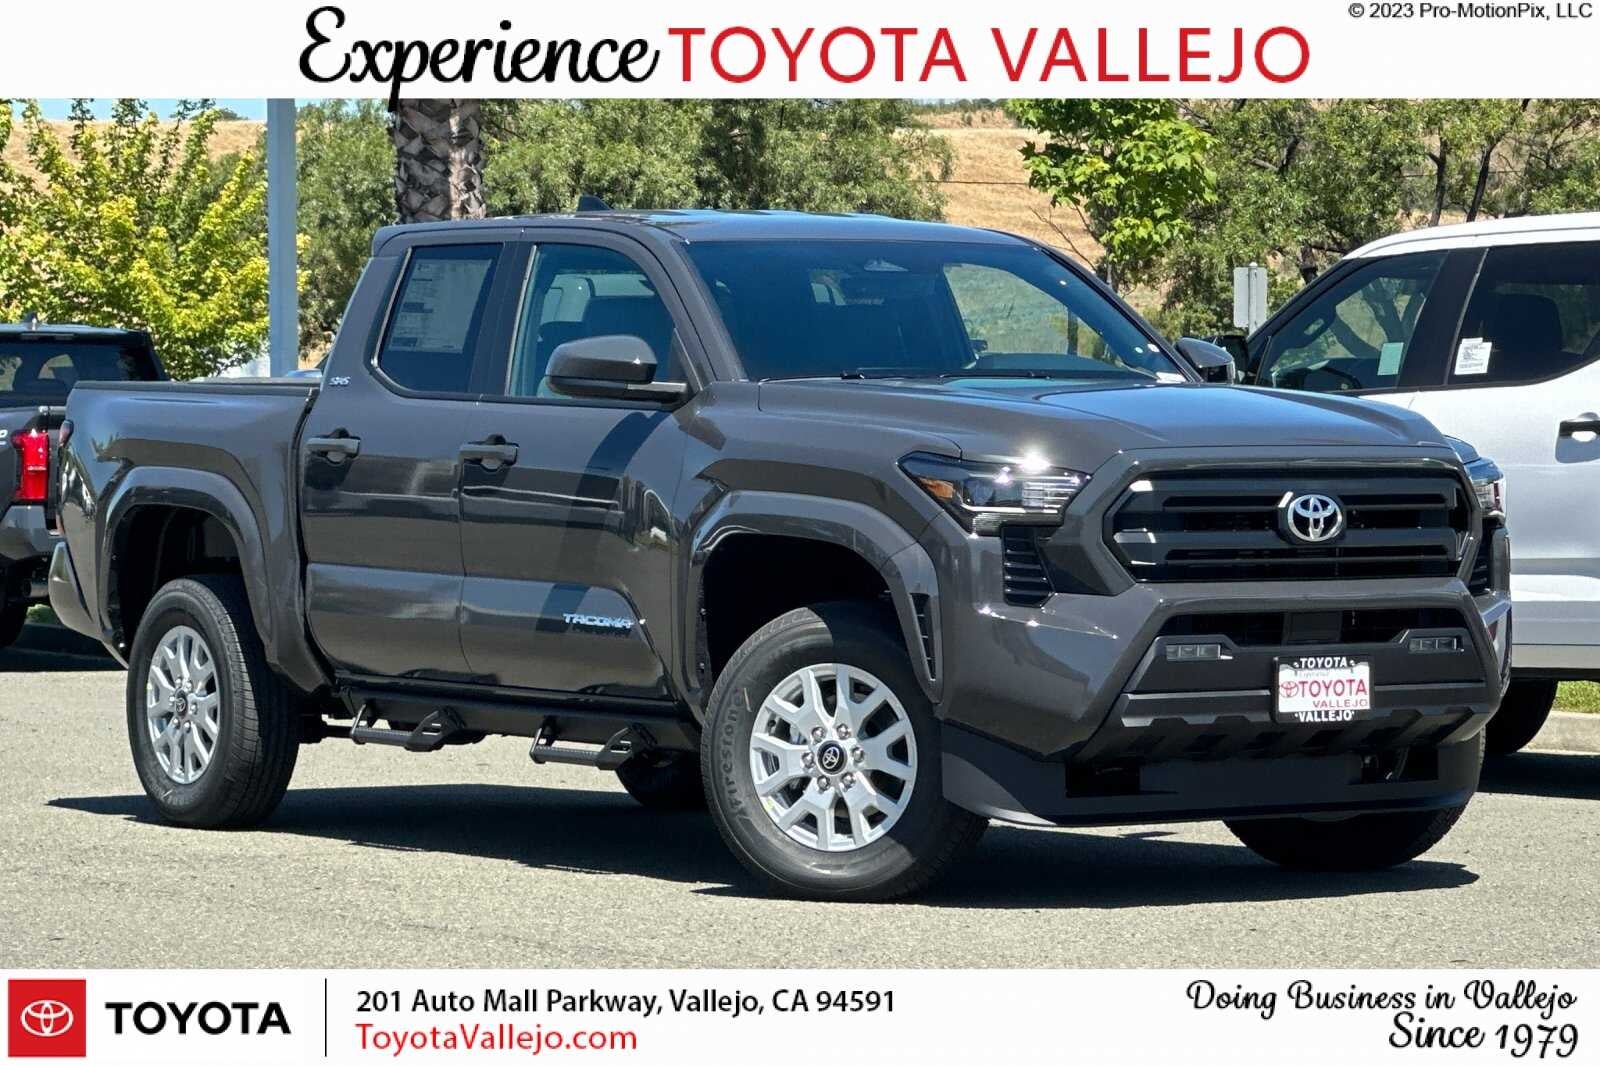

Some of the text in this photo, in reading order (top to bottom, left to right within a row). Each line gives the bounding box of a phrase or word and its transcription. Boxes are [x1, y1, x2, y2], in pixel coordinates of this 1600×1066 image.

[563, 613, 634, 629] TACOMA
[1299, 656, 1348, 669] TOYOTA
[1299, 679, 1368, 698] TOYOTA
[1312, 698, 1368, 709] VALLEJO
[1299, 709, 1352, 722] VALLEJO
